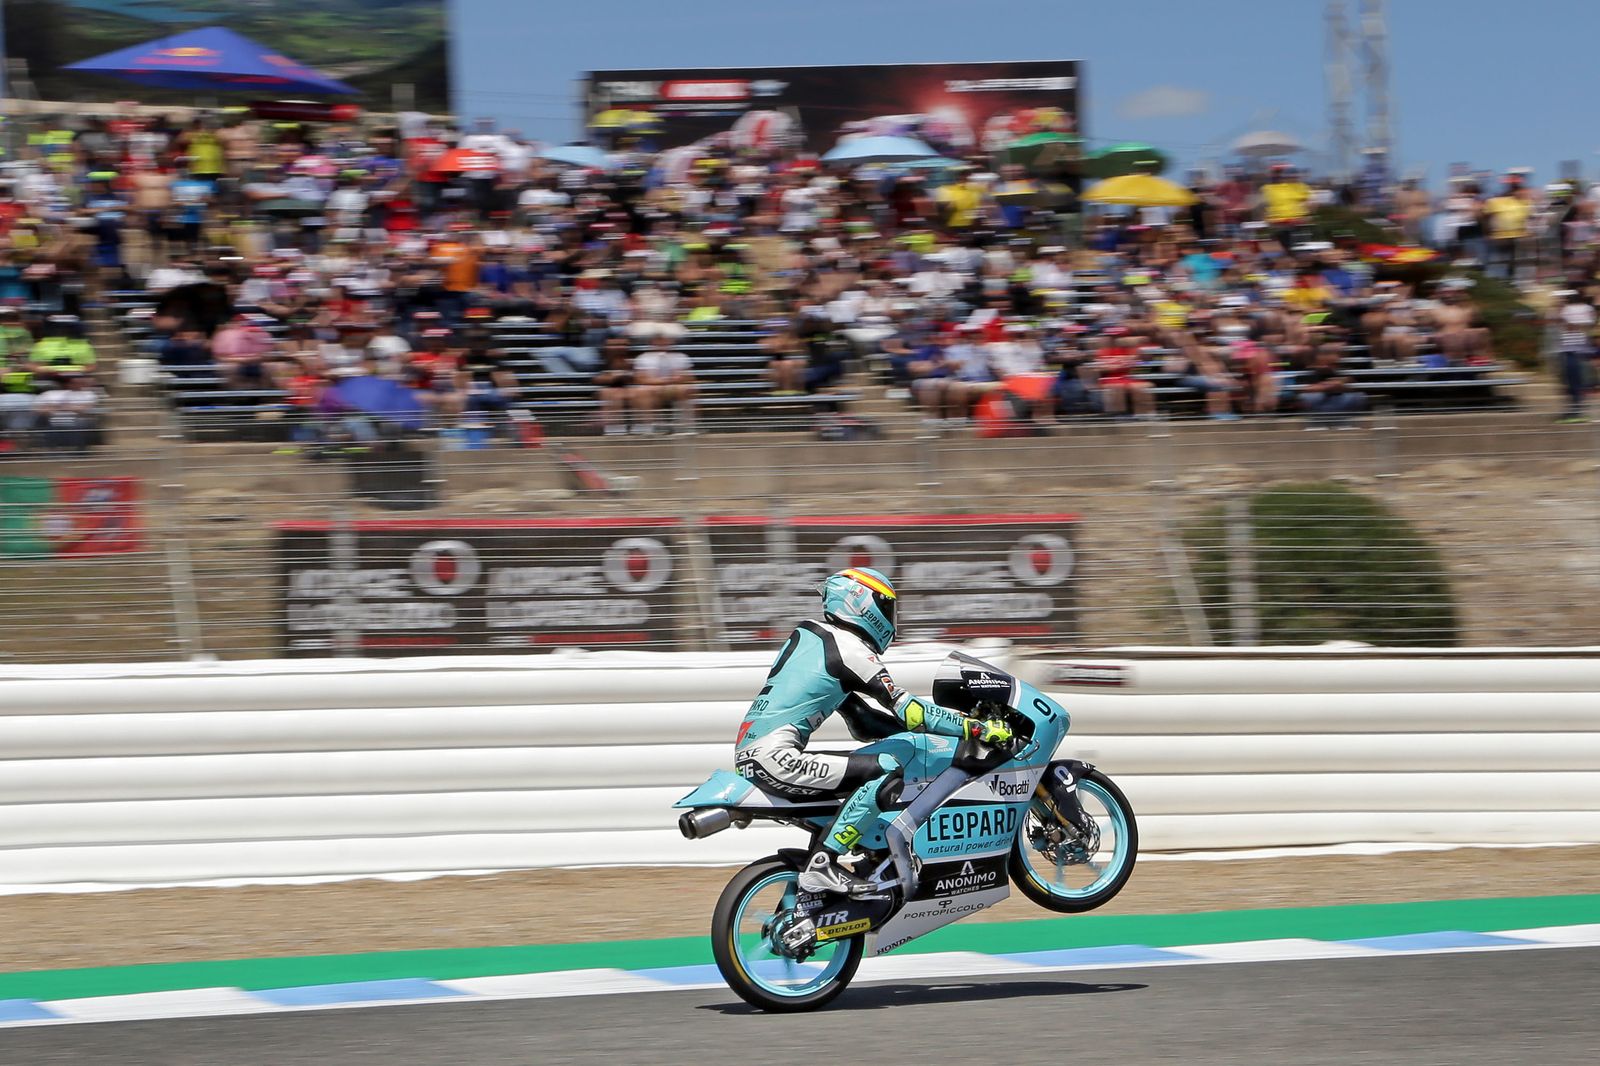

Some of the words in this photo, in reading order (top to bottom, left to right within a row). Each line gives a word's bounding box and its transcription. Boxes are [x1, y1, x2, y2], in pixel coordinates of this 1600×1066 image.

[860, 606, 885, 633] LEOPARD
[925, 705, 964, 727] LEOPARD
[771, 749, 830, 778] LEOPARD
[999, 779, 1030, 796] Bonatti
[927, 807, 1017, 842] LEOPARD
[928, 842, 964, 854] natural
[965, 840, 994, 853] power
[935, 871, 997, 891] ANONIMO
[951, 885, 980, 895] WATCHES
[903, 902, 985, 920] PORTOPICCOLO
[828, 922, 867, 935] DUNLOP
[876, 935, 913, 955] HONDA
